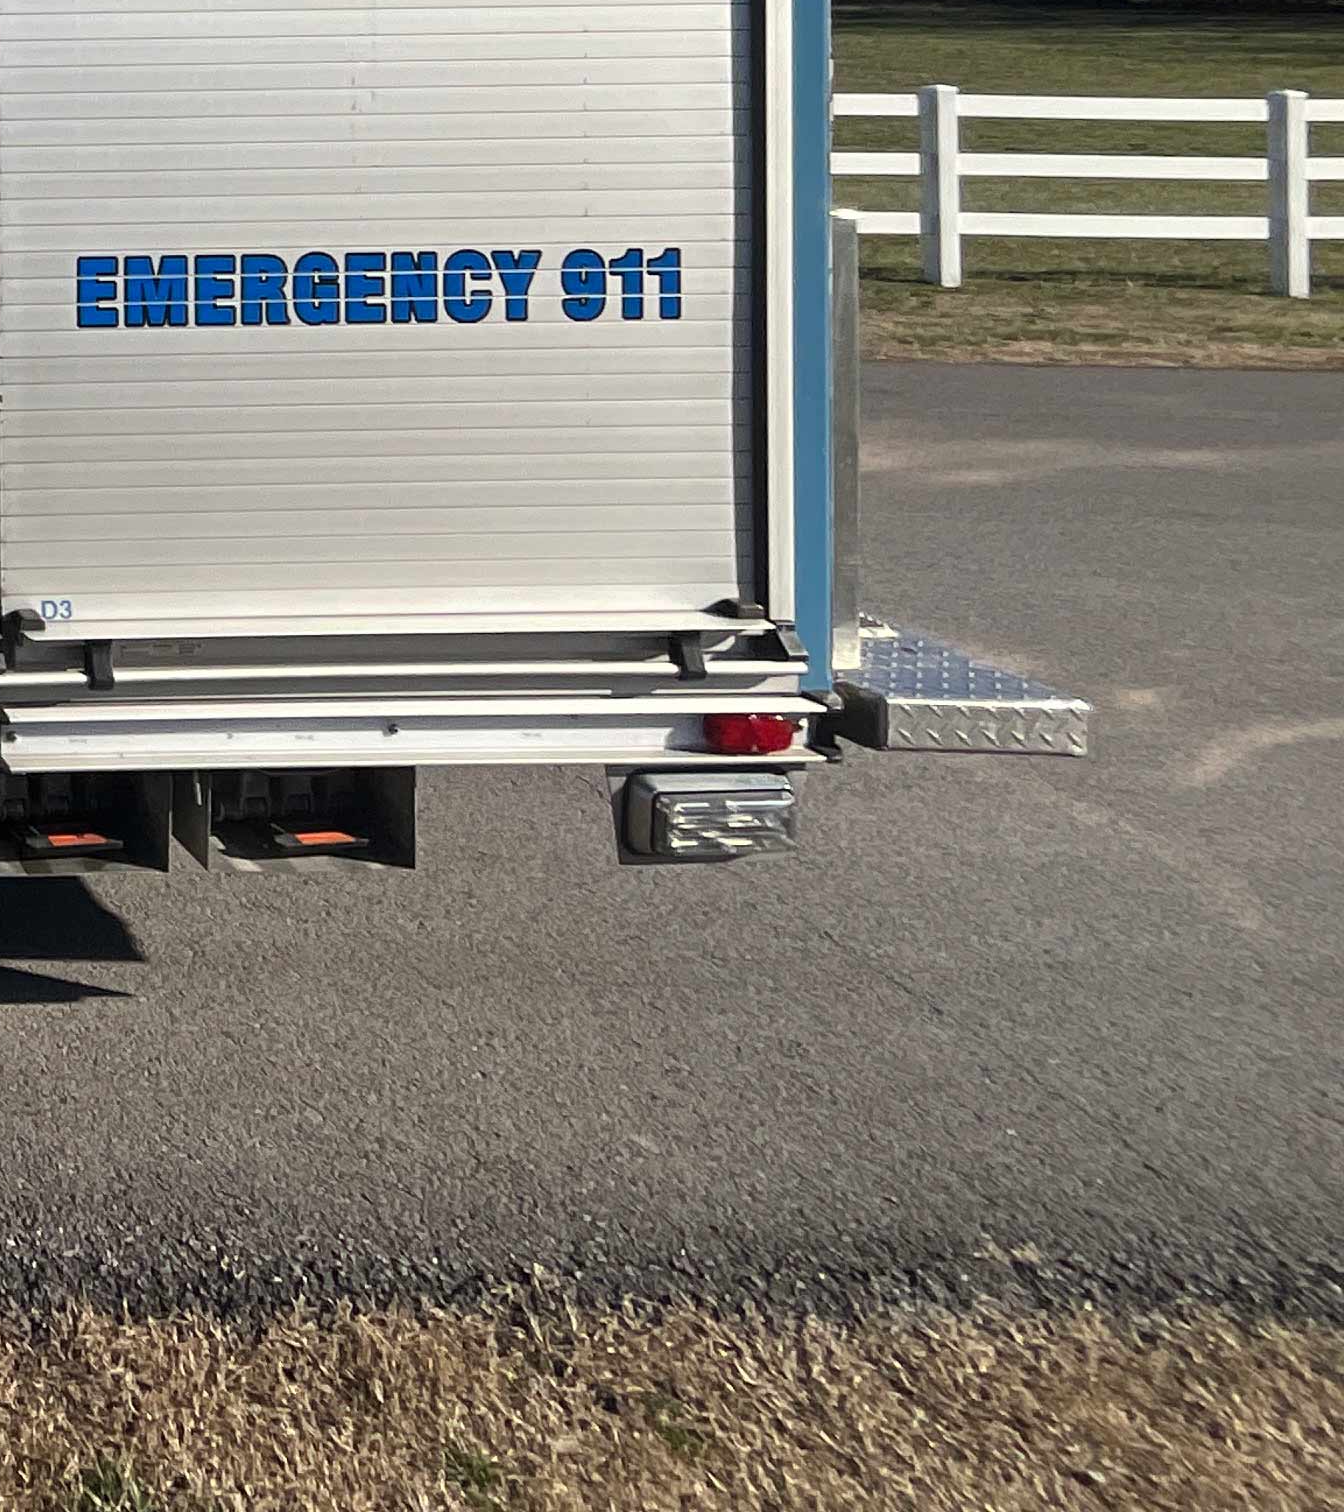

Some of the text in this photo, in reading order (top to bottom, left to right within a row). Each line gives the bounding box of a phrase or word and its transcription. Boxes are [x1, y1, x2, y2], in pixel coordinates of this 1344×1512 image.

[77, 247, 682, 328] EMERGENCY 911
[41, 600, 72, 619] D3
